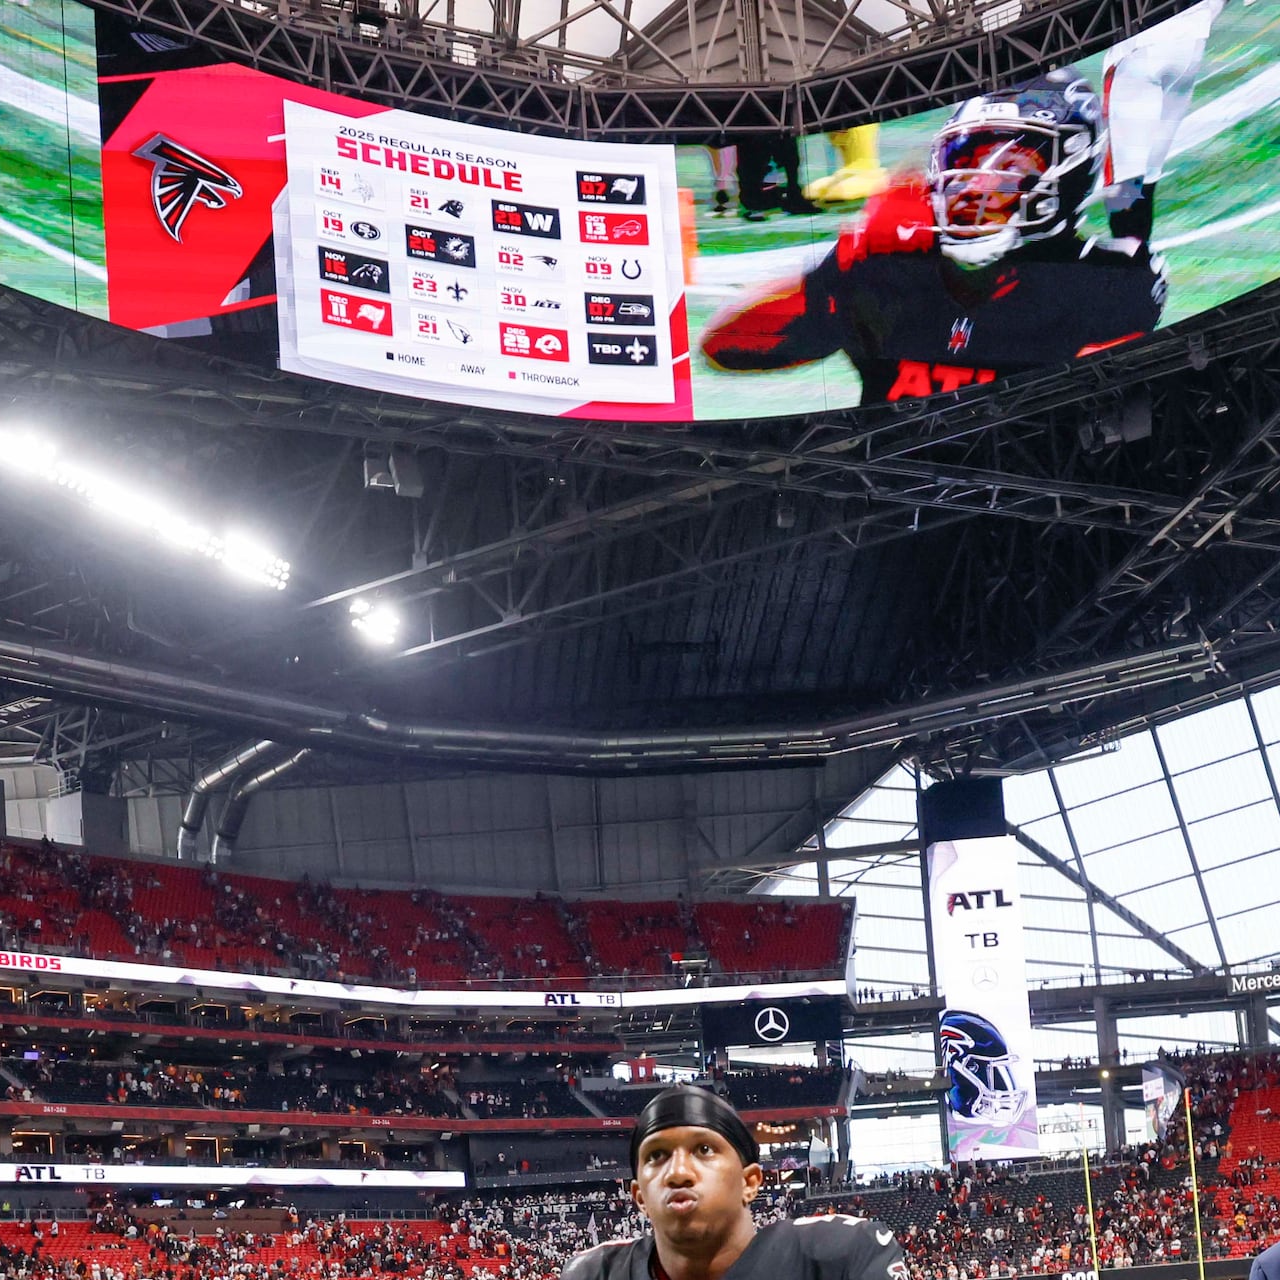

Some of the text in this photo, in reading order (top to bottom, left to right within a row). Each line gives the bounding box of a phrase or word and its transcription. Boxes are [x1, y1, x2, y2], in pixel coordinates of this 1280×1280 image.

[339, 126, 517, 169] 2025 REGULAR SEASON
[335, 136, 523, 192] SCHEDULE
[321, 168, 340, 176] SEP
[320, 174, 341, 189] 14
[410, 188, 428, 196] SEP
[580, 182, 607, 194] 07
[410, 195, 429, 209] 21
[498, 204, 517, 212] SEP
[323, 210, 342, 219] OCT
[323, 216, 343, 231] 19
[585, 222, 606, 235] 13
[412, 229, 432, 239] OCT
[325, 252, 345, 261] NOV
[498, 252, 524, 266] 02
[585, 262, 612, 274] 09
[415, 271, 434, 279] NOV
[413, 278, 437, 292] 23
[503, 286, 522, 294] NOV
[328, 294, 348, 304] DEC
[501, 292, 526, 306] 30
[531, 300, 562, 309] JETS
[331, 301, 346, 317] 11
[588, 303, 615, 316] 07
[418, 313, 436, 321] DEC
[419, 320, 437, 334] 21
[506, 327, 525, 335] DEC
[504, 333, 530, 348] 29
[592, 344, 621, 354] TBD
[398, 352, 425, 366] HOME
[461, 364, 485, 375] AWAY
[522, 372, 579, 387] THROWBACK
[948, 889, 1012, 916] ATL
[964, 932, 999, 948] TB
[545, 994, 615, 1006] ATL TB
[16, 1164, 106, 1183] ATL TB
[543, 1204, 578, 1213] NEST
